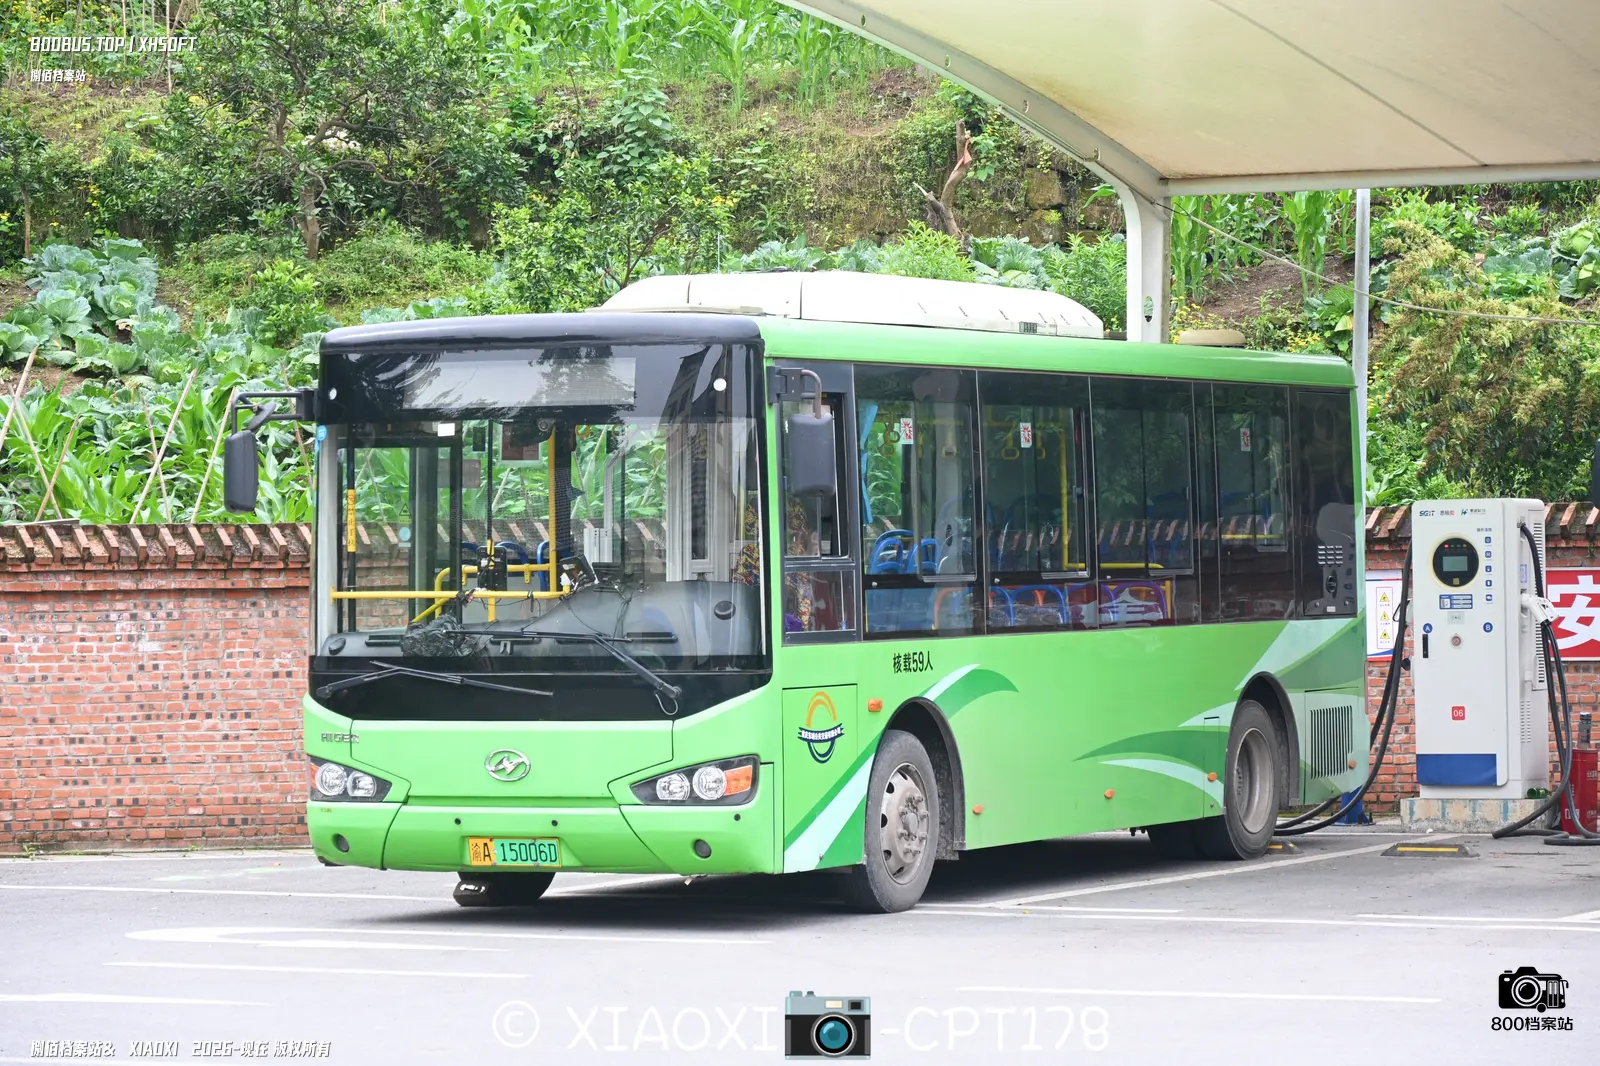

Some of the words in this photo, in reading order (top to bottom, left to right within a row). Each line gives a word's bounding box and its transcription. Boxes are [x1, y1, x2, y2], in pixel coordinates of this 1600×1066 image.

[1547, 575, 1600, 650] 安
[1424, 623, 1432, 632] A
[1485, 623, 1492, 631] B
[892, 651, 932, 674] 核载59人
[1453, 708, 1464, 719] 06
[500, 842, 558, 863] 15006D
